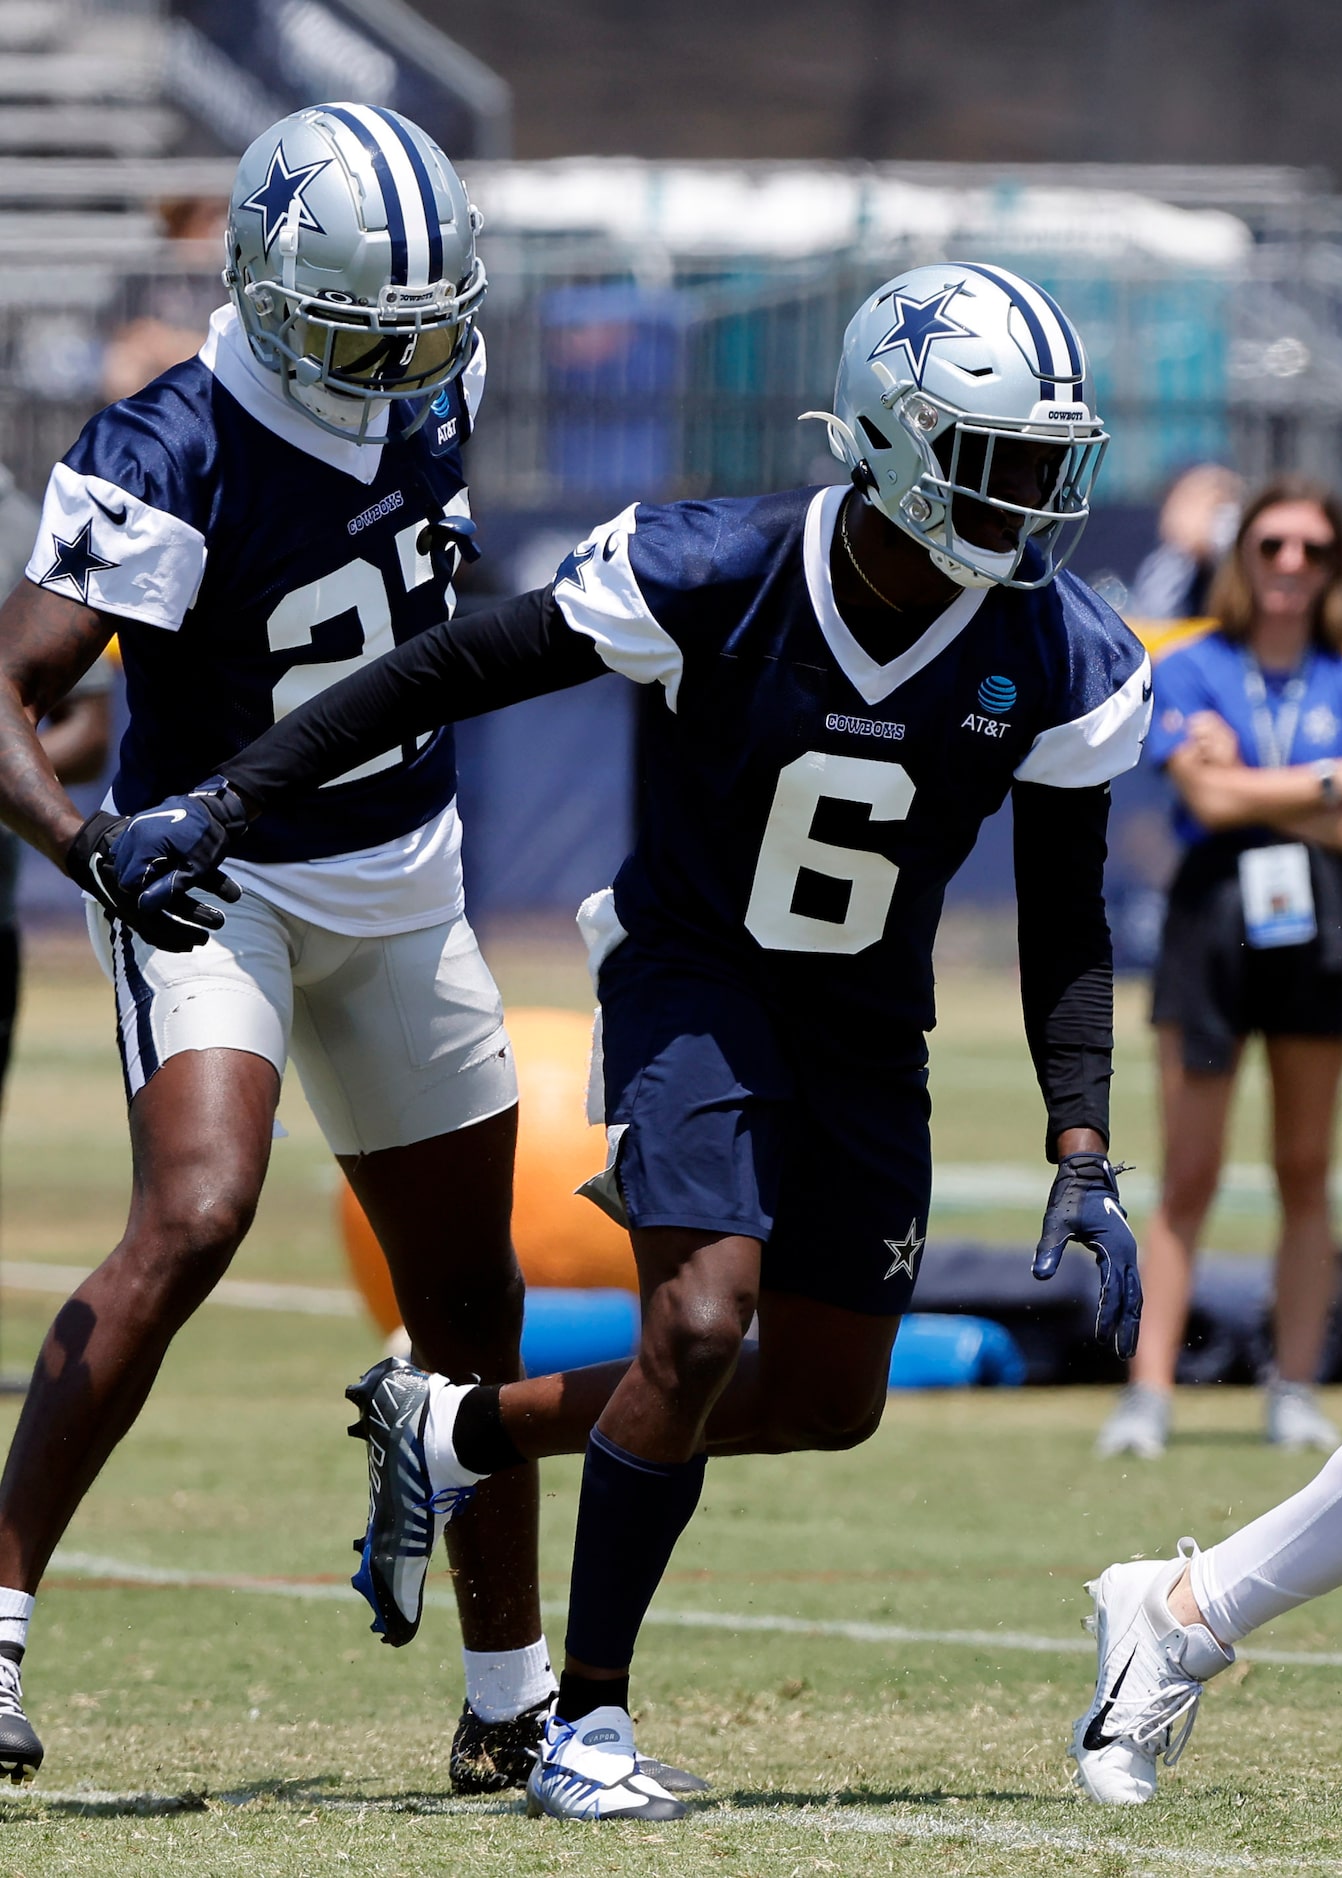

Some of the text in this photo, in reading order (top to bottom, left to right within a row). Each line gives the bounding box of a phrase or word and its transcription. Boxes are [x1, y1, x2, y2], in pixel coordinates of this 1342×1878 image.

[1048, 411, 1084, 421] COWBOYS
[436, 417, 457, 446] AT&T
[347, 490, 404, 535] COWBOYS
[825, 713, 906, 740] COWBOYS
[961, 713, 1012, 739] AT&T
[743, 750, 917, 955] 6
